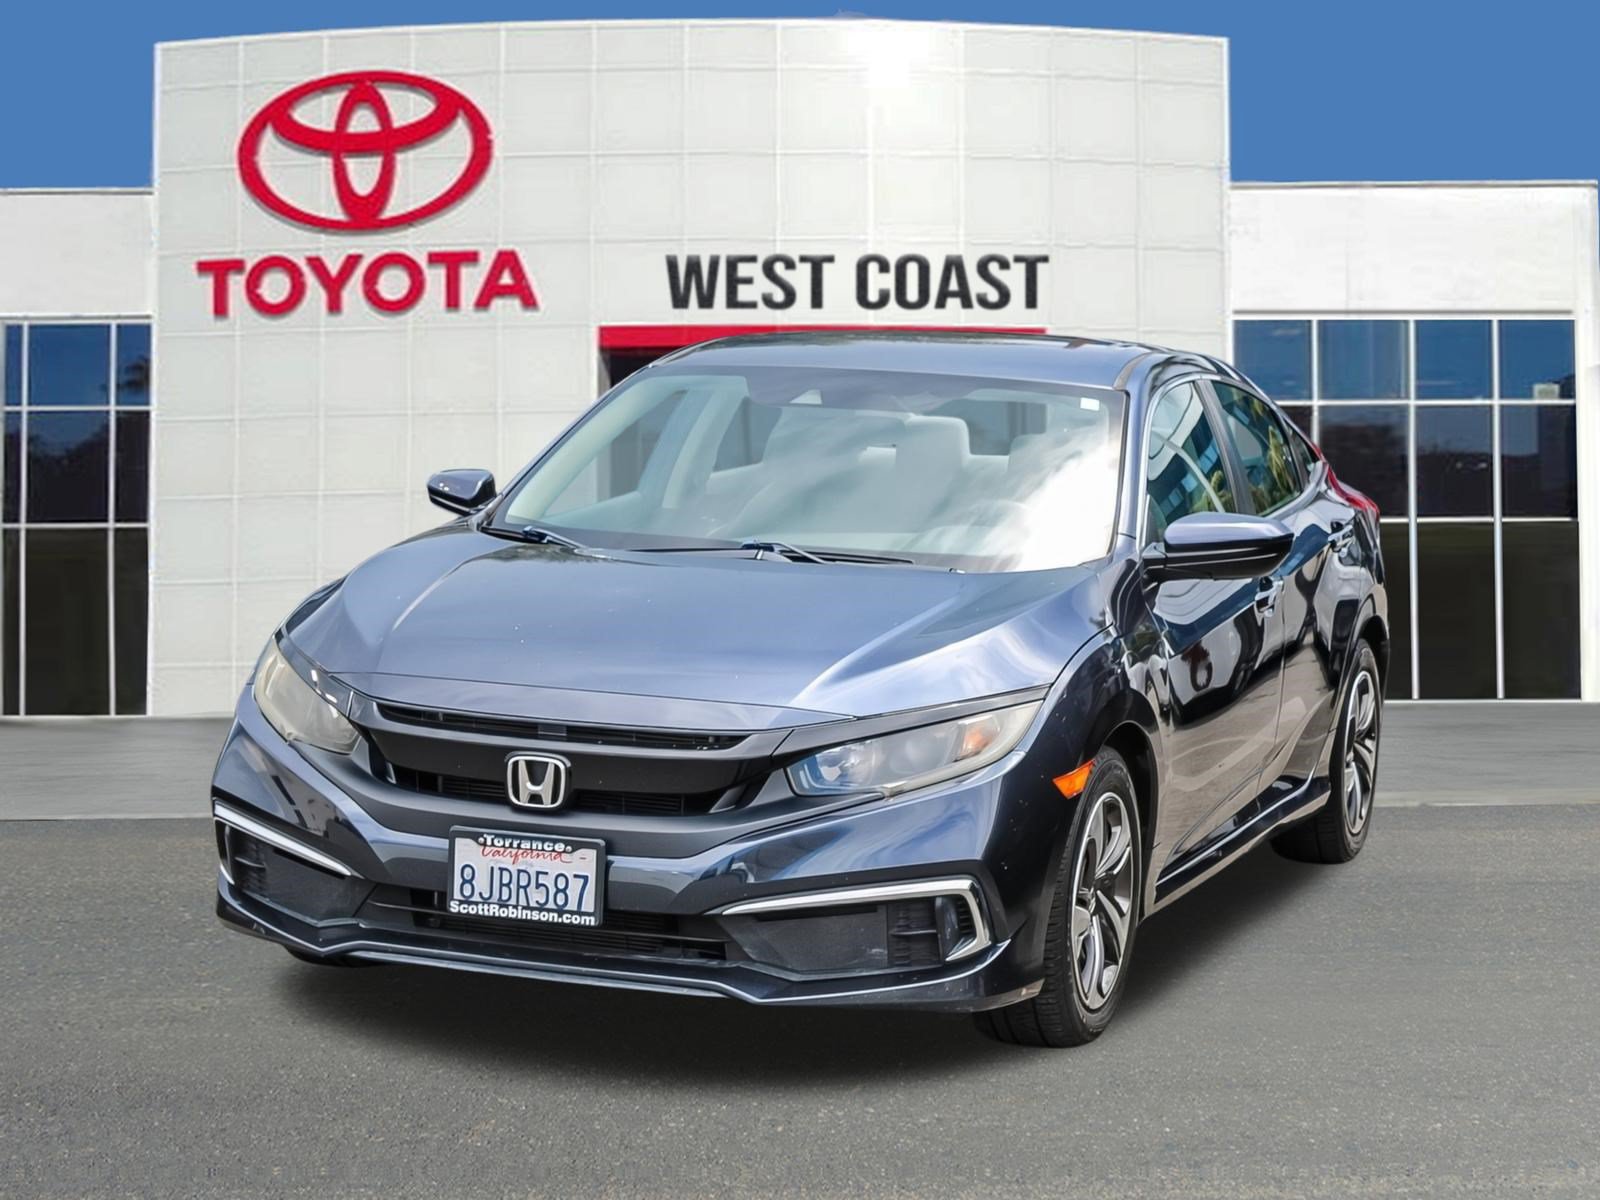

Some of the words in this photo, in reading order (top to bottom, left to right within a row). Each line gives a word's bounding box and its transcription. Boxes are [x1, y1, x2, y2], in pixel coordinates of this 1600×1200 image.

[197, 249, 538, 318] TOYOTA
[666, 254, 835, 310] WEST
[855, 254, 1050, 310] COAST
[482, 834, 566, 853] Torrance
[459, 863, 590, 912] 8JBR587
[449, 900, 596, 927] ScottRobinson.com
